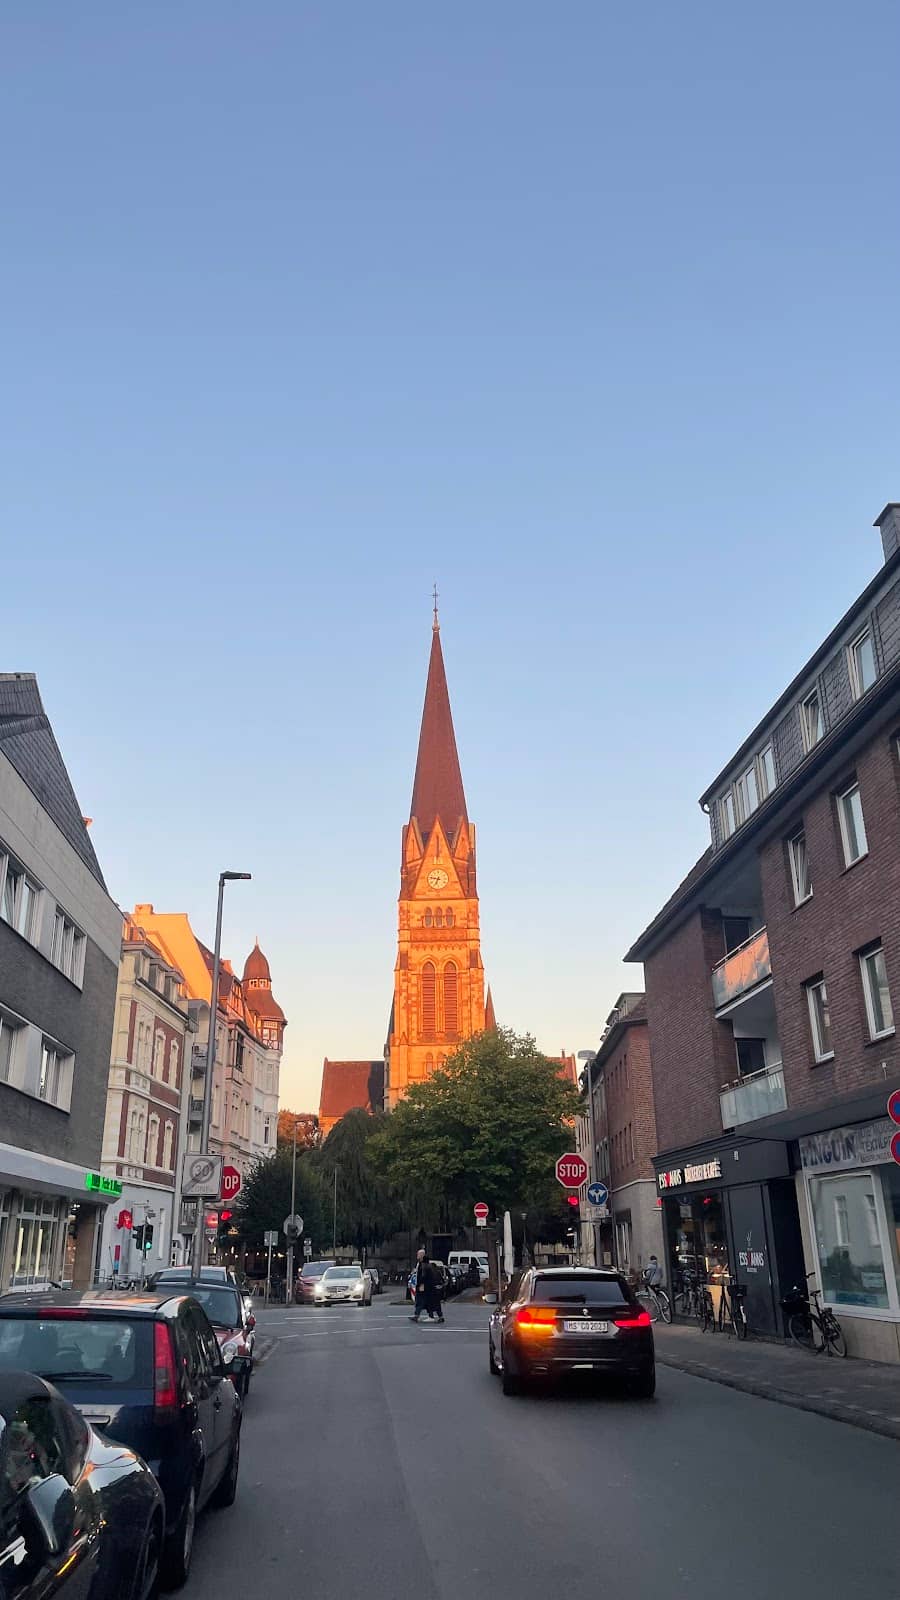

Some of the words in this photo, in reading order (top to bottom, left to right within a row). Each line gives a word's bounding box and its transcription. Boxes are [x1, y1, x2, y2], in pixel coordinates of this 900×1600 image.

[195, 1165, 210, 1177] 30
[559, 1164, 586, 1177] STOP
[222, 1175, 239, 1190] OP
